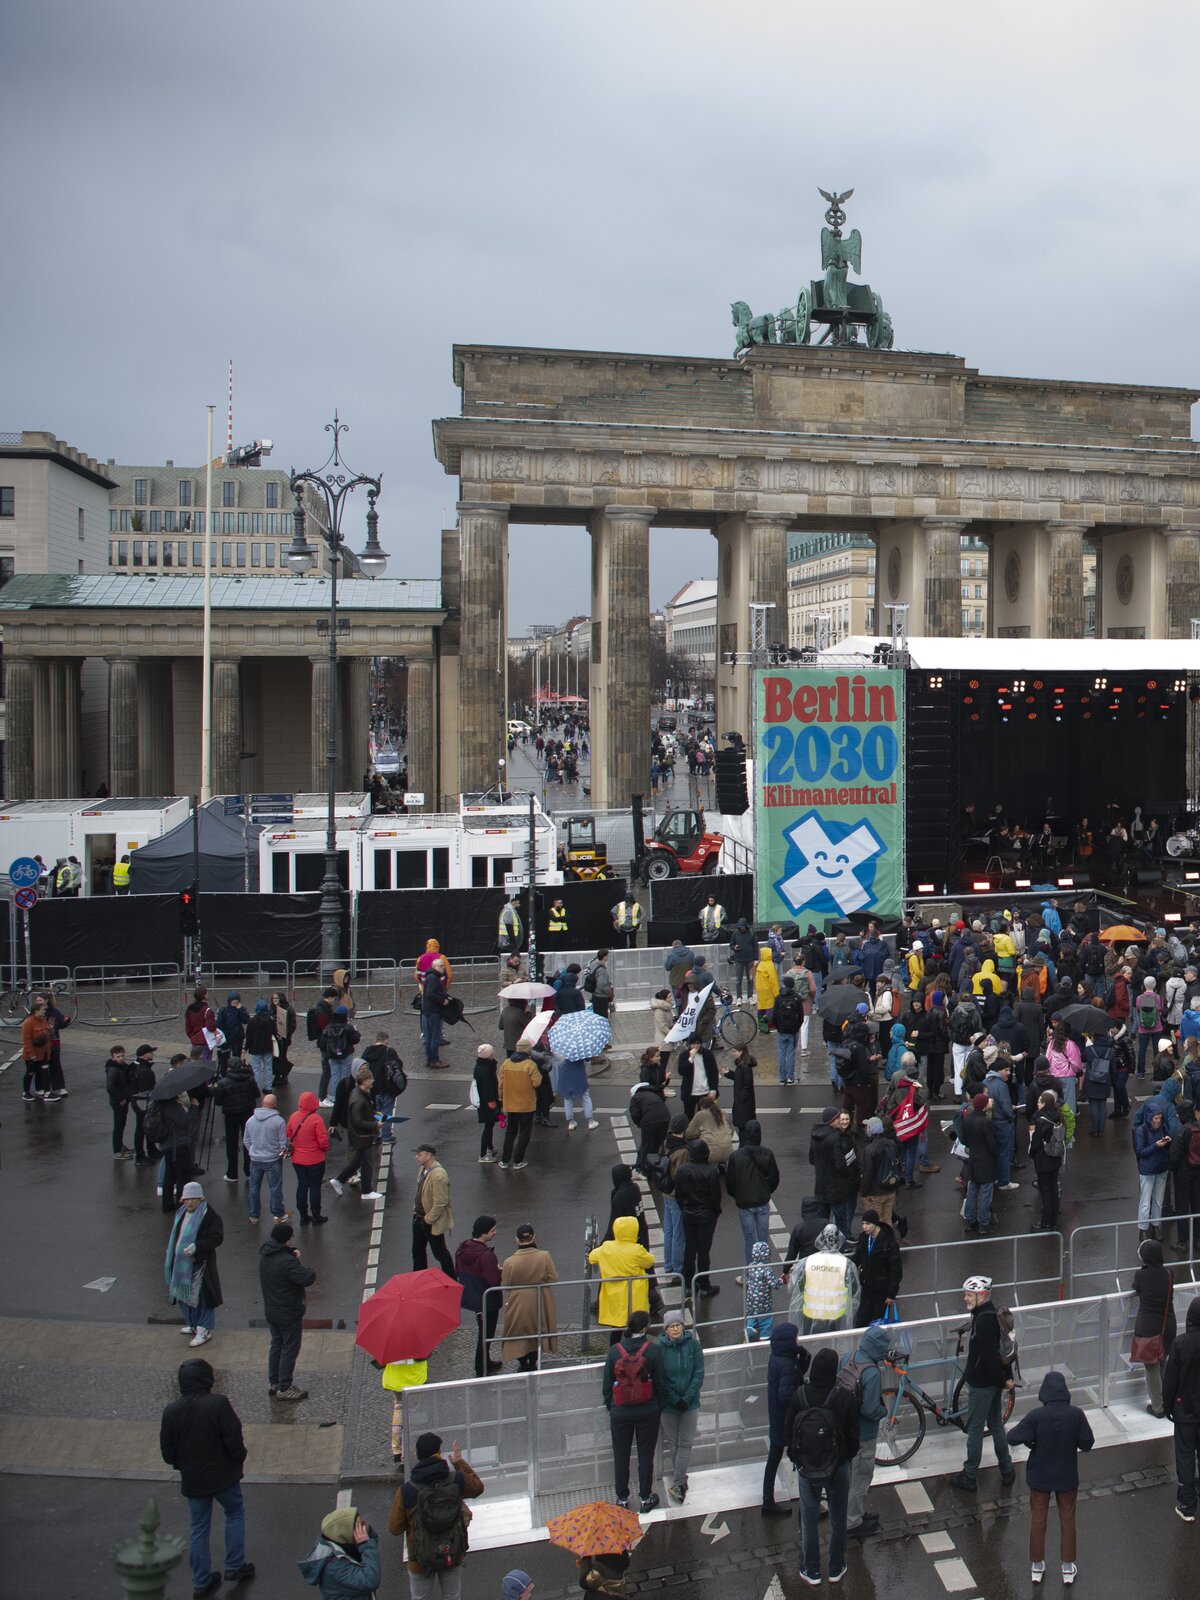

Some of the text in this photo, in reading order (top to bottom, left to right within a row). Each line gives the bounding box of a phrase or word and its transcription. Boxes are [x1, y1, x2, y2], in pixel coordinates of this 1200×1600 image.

[763, 675, 897, 723] Berlin
[762, 725, 898, 782] 2030
[763, 783, 897, 807] Klimaneutral
